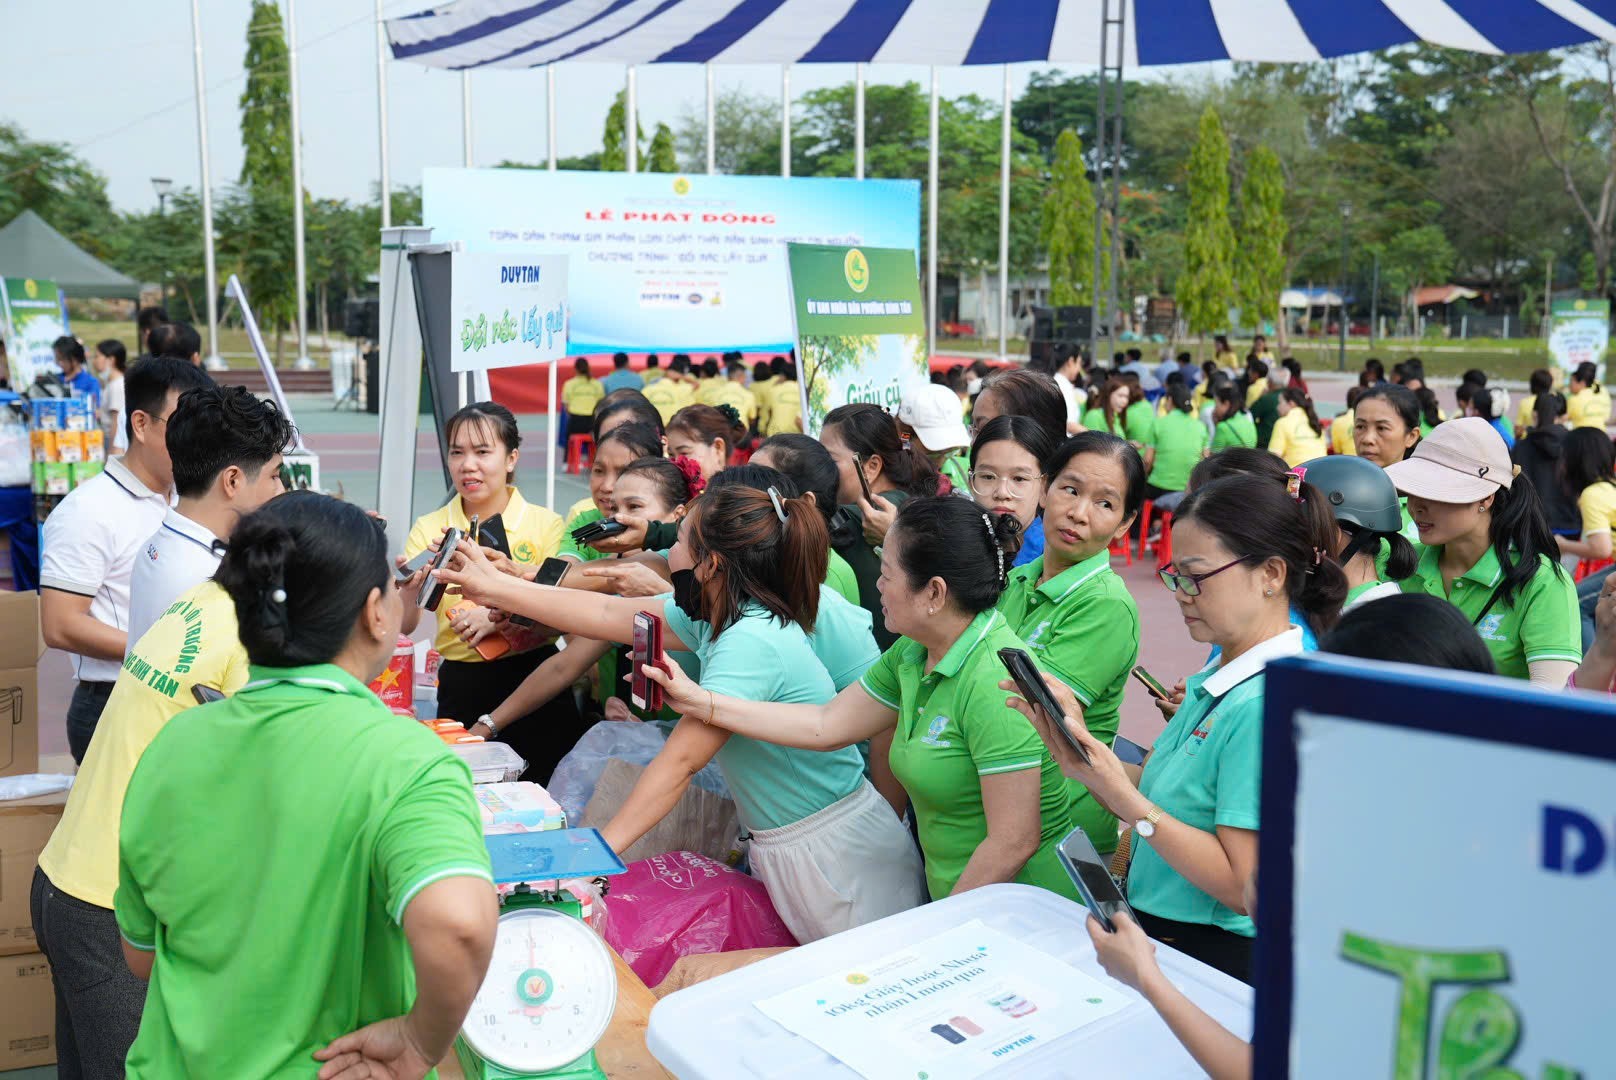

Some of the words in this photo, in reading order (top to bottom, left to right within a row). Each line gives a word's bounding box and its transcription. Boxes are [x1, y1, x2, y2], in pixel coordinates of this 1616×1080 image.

[501, 266, 539, 283] DUYTAN
[148, 669, 179, 698] TÂN
[1542, 804, 1616, 876] D
[572, 1004, 580, 1016] 5
[483, 1014, 496, 1026] 10
